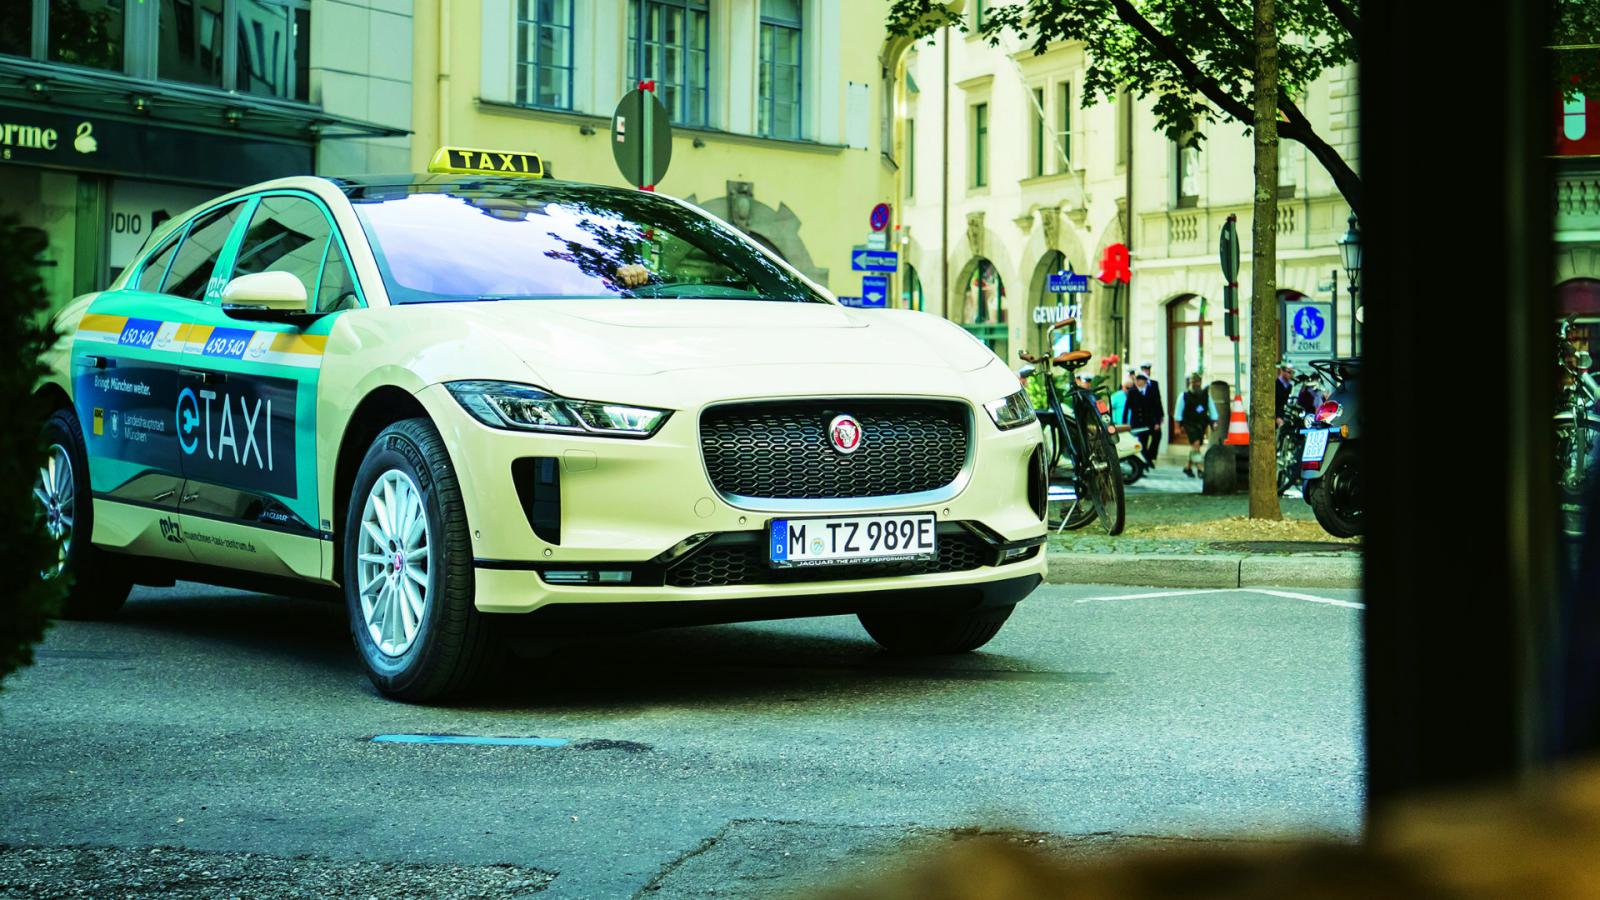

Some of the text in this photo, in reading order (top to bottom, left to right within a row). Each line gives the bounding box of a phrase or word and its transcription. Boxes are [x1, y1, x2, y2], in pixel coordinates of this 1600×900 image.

[0, 123, 58, 150] rme
[459, 151, 528, 172] TAXI
[111, 212, 142, 234] DIO
[121, 328, 138, 344] 450
[136, 330, 154, 345] 540
[1298, 341, 1320, 351] ZONE
[206, 338, 226, 354] 450
[225, 340, 246, 356] 540
[95, 375, 151, 396] Bringt München weiter.
[124, 412, 165, 432] Landeshauptstadt
[124, 426, 148, 442] München
[789, 518, 933, 555] M TZ 989E
[776, 545, 783, 554] D
[797, 559, 834, 567] JAGUAR
